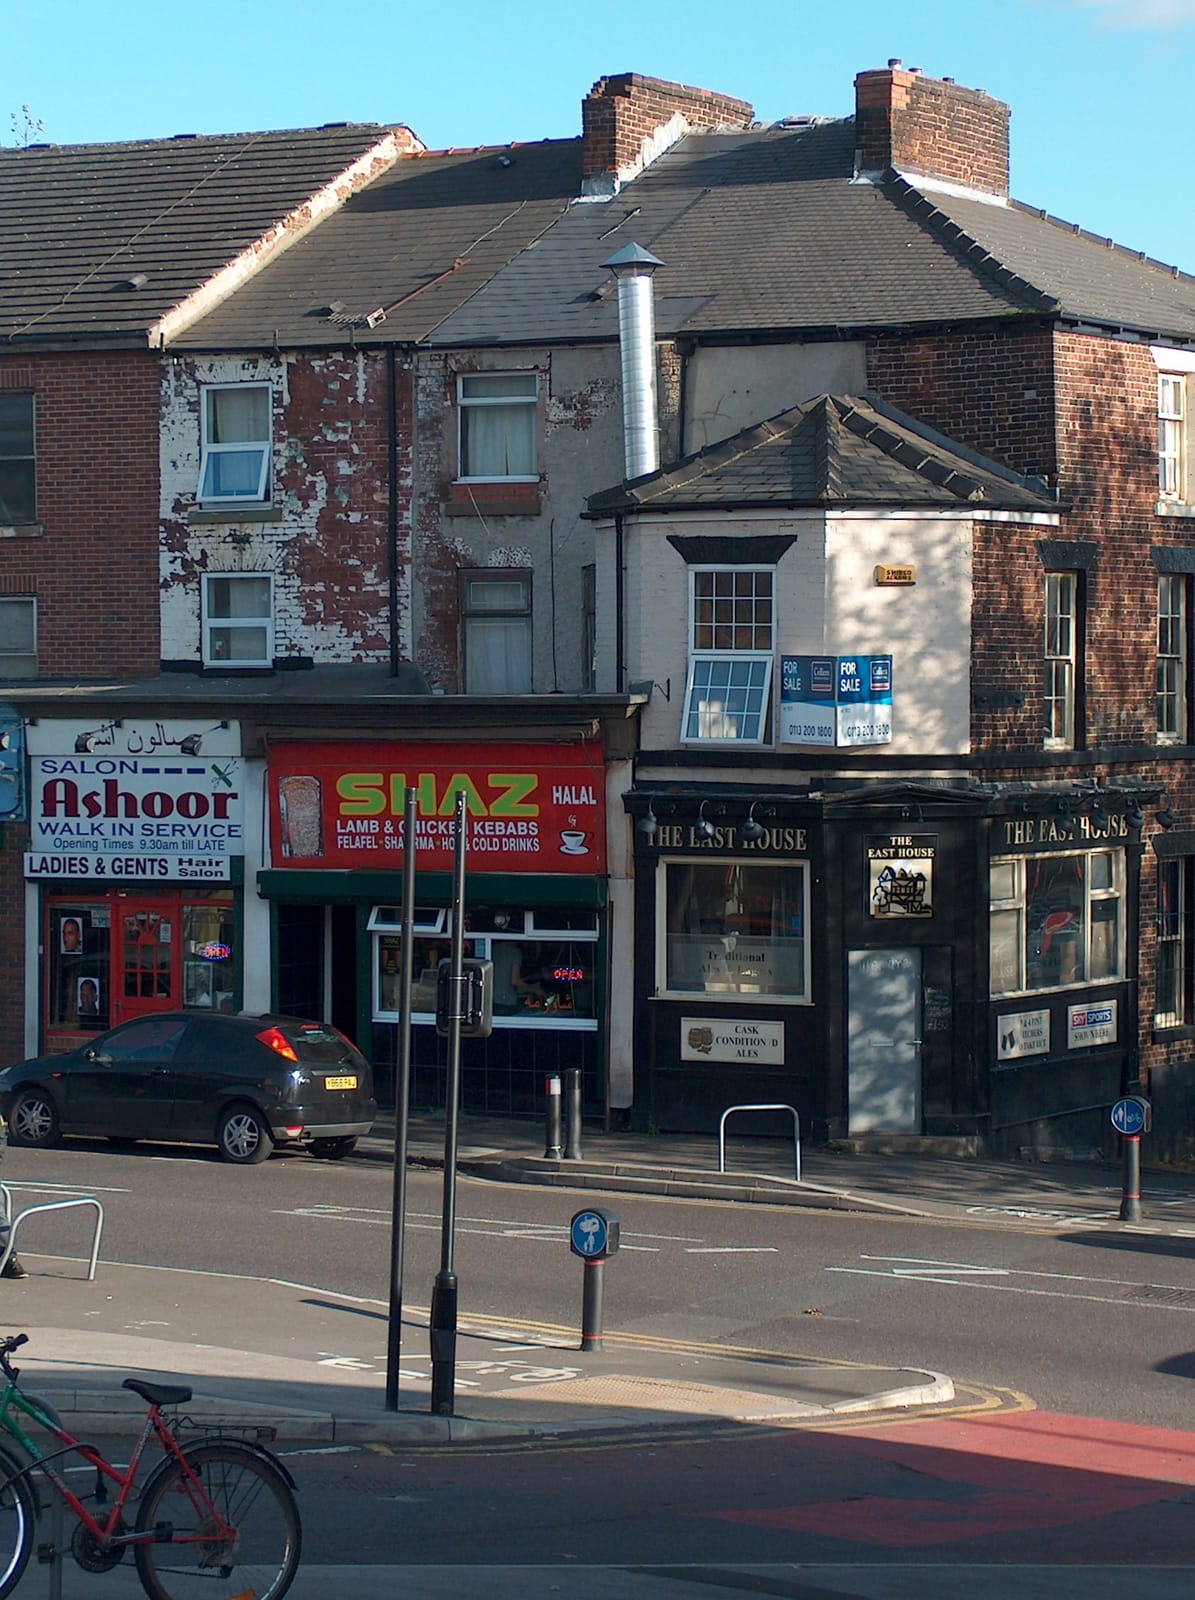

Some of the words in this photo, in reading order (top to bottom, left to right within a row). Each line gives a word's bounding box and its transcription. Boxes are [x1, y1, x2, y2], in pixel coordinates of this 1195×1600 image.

[784, 661, 798, 674] FOR
[840, 661, 857, 676] FOR
[784, 678, 801, 691] SALE
[840, 678, 861, 692] SALE
[789, 724, 802, 736] 0113
[804, 725, 816, 736] 200
[818, 726, 833, 738] 1800
[862, 725, 874, 737] 200
[40, 760, 139, 774] SALON
[40, 778, 239, 819] Ashoor
[336, 773, 540, 817] SHAZ
[552, 785, 598, 805] HALAL
[38, 822, 105, 836] WALK
[112, 823, 134, 836] IN
[141, 823, 242, 839] SERVICE
[336, 819, 380, 834] LAMB
[383, 819, 395, 834] &
[398, 820, 470, 835] CICKE
[473, 821, 539, 836] KEBABS
[1005, 819, 1035, 845] THE
[1079, 814, 1128, 840] HOUSE
[648, 825, 683, 848] THE
[889, 836, 913, 846] THE
[53, 837, 99, 851] Opening
[102, 839, 134, 850] Times
[140, 839, 178, 851] 9.30am
[181, 839, 194, 851] till
[198, 840, 225, 851] LATE
[337, 836, 378, 849] FELAFEL
[384, 836, 435, 849] SHARMA
[442, 837, 457, 850] HO
[473, 837, 500, 851] COLD
[502, 838, 540, 852] DRINKS
[868, 848, 896, 858] EAST
[898, 848, 935, 857] HOUSE
[29, 856, 89, 875] LADIES
[95, 857, 105, 875] &
[111, 857, 169, 876] GENTS
[178, 858, 224, 867] Hair
[178, 868, 224, 878] Salon
[552, 969, 584, 980] OPEN
[1073, 1015, 1086, 1026] SKY
[1087, 1010, 1111, 1023] SPORTS
[735, 1025, 759, 1035] CASK
[716, 1036, 779, 1048] CONDITIOND
[736, 1049, 759, 1058] ALES
